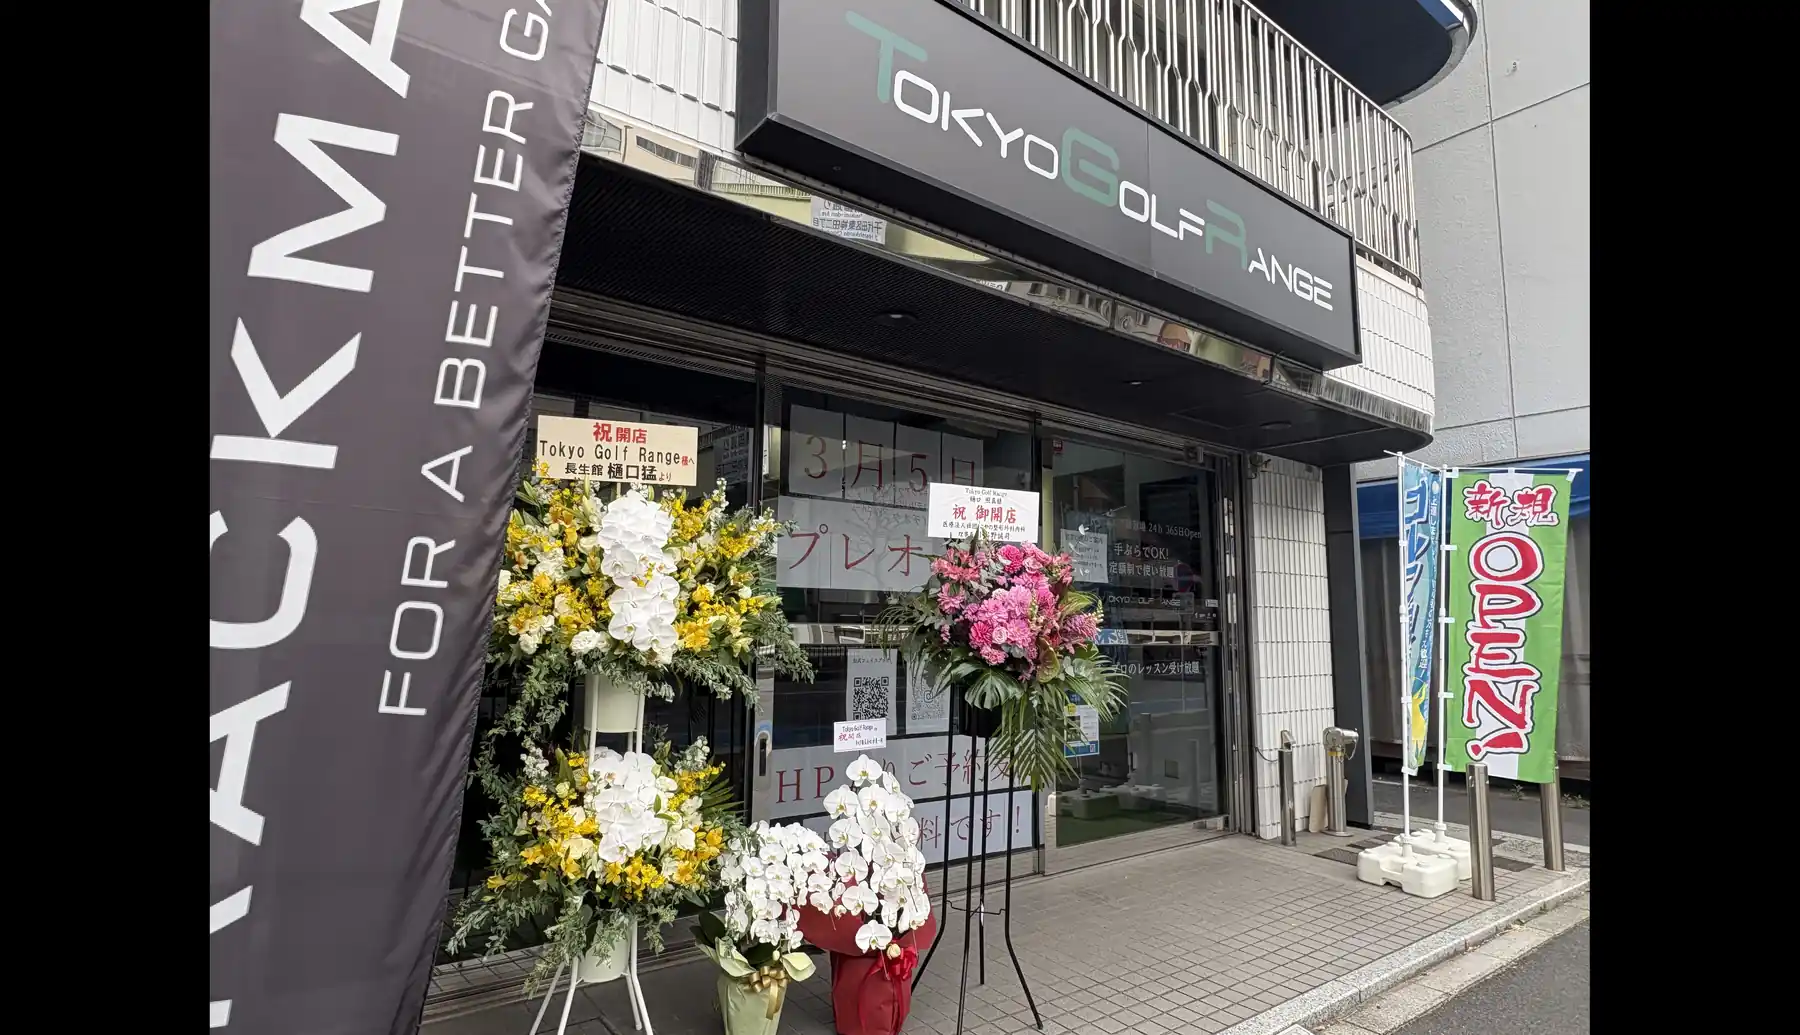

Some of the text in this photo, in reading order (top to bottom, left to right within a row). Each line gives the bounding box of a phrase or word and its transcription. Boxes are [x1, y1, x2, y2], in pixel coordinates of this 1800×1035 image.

[845, 11, 1333, 311] TOKYO GOLF RANGE
[378, 0, 553, 716] FOR A BETTER G
[540, 440, 585, 460] Tokyo
[595, 444, 628, 461] Golf
[564, 463, 604, 477] 長生館
[952, 504, 1016, 523] 祝 御開店
[1463, 480, 1558, 528] 新規
[1462, 532, 1544, 760] OPEN!
